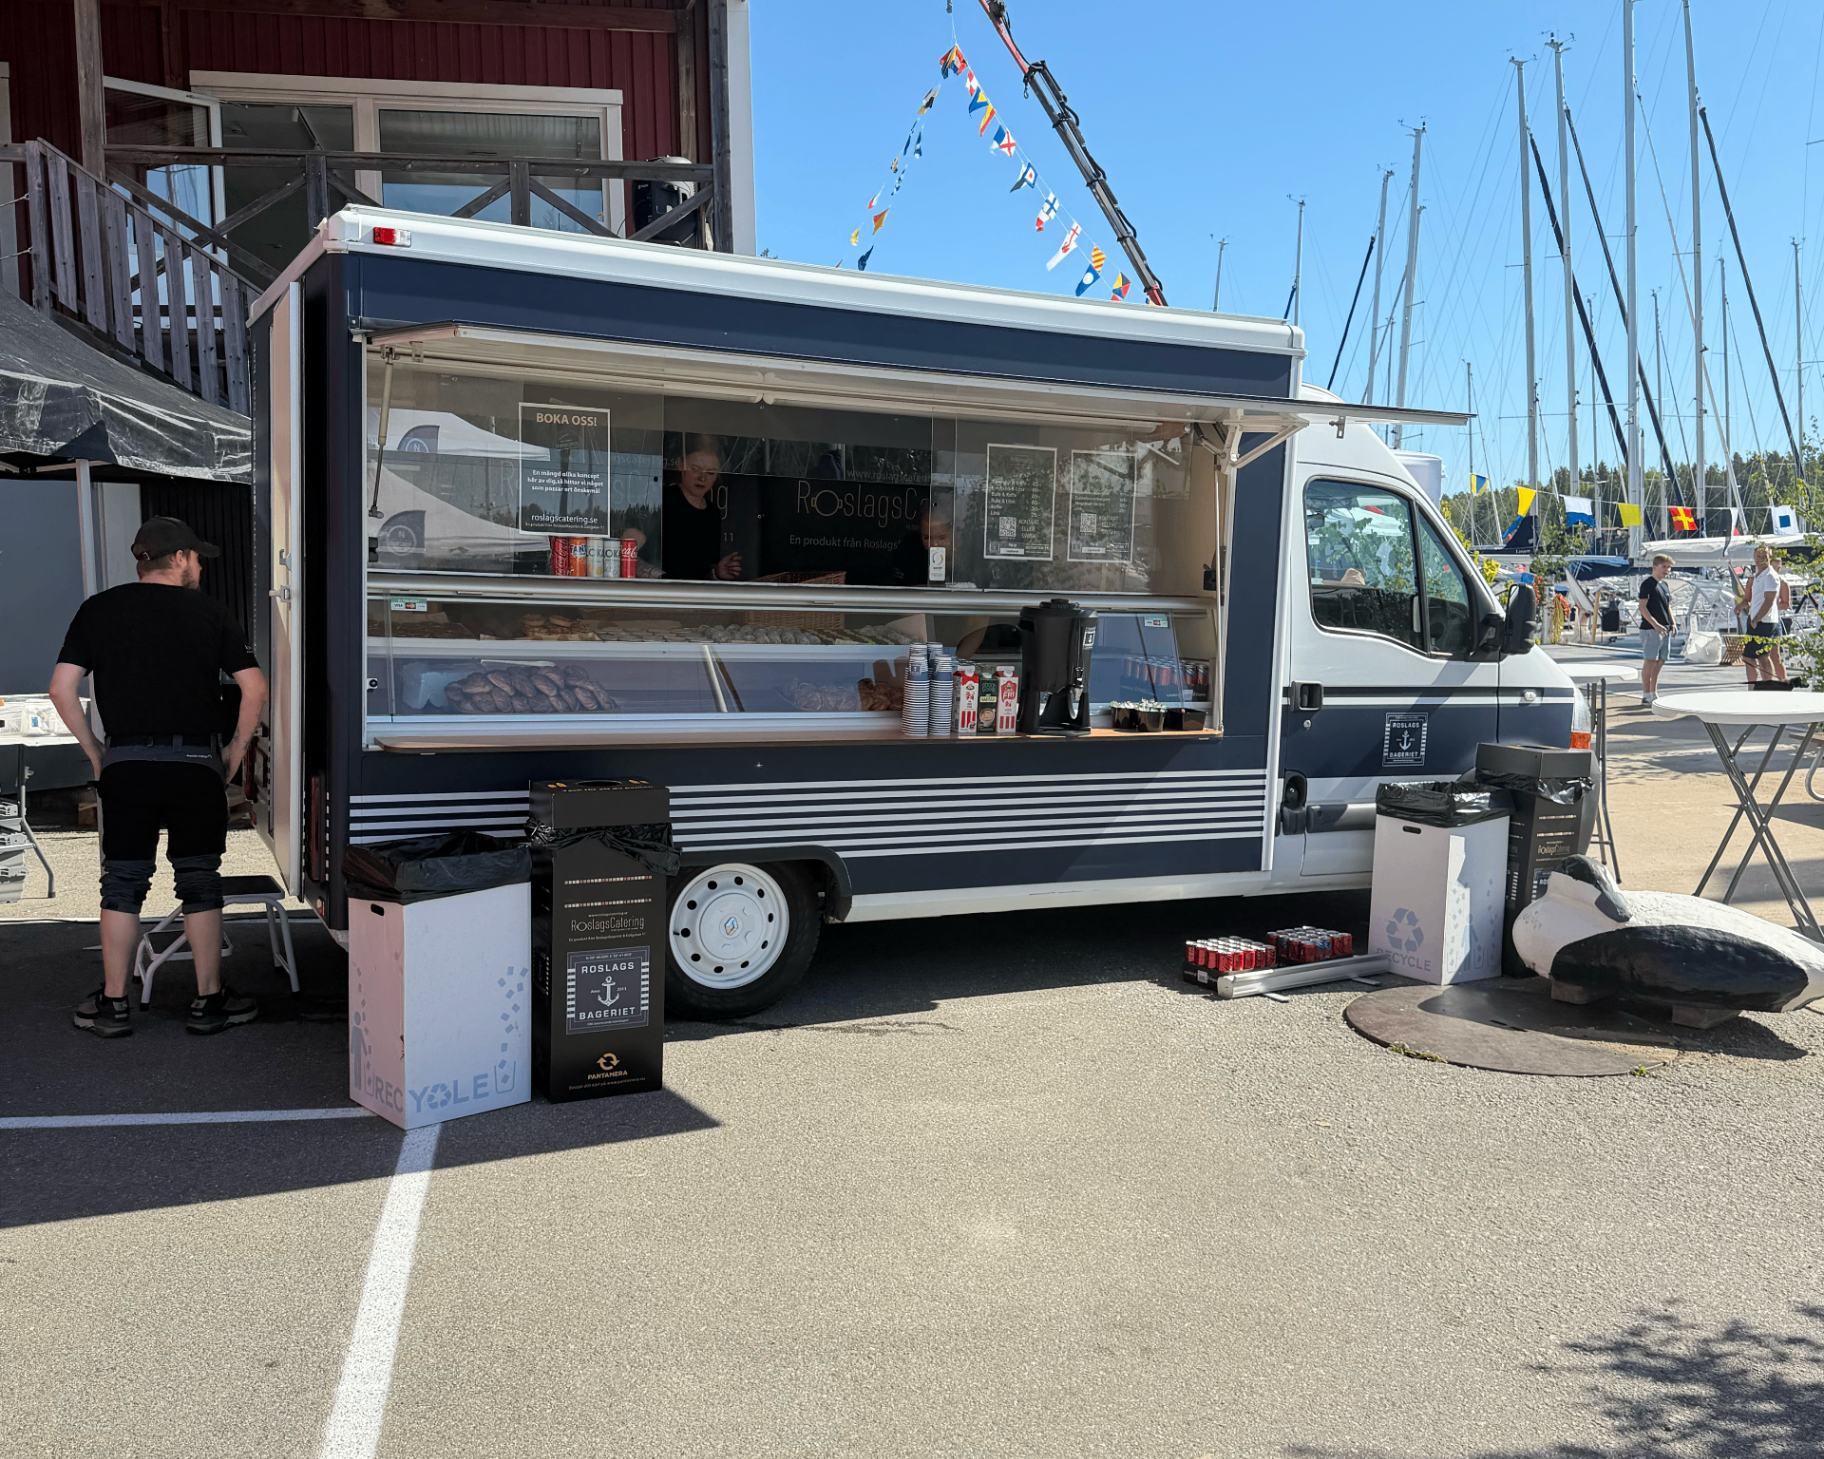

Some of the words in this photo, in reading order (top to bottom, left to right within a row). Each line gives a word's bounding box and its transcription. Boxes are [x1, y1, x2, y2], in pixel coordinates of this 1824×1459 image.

[536, 412, 568, 424] BOKA
[572, 415, 598, 427] OSS!
[577, 472, 600, 480] koncept
[798, 480, 928, 528] RoslagsC
[531, 514, 598, 525] roslagscatering.se
[723, 532, 734, 542] 11
[790, 534, 801, 545] En
[804, 536, 841, 547] produkt
[843, 537, 862, 548] från
[864, 539, 901, 551] Roslags
[571, 916, 645, 932] RoslagsCatering
[581, 962, 635, 974] ROSLAGS
[579, 1006, 636, 1020] BAGERIET
[588, 1070, 628, 1080] PANTAMERA
